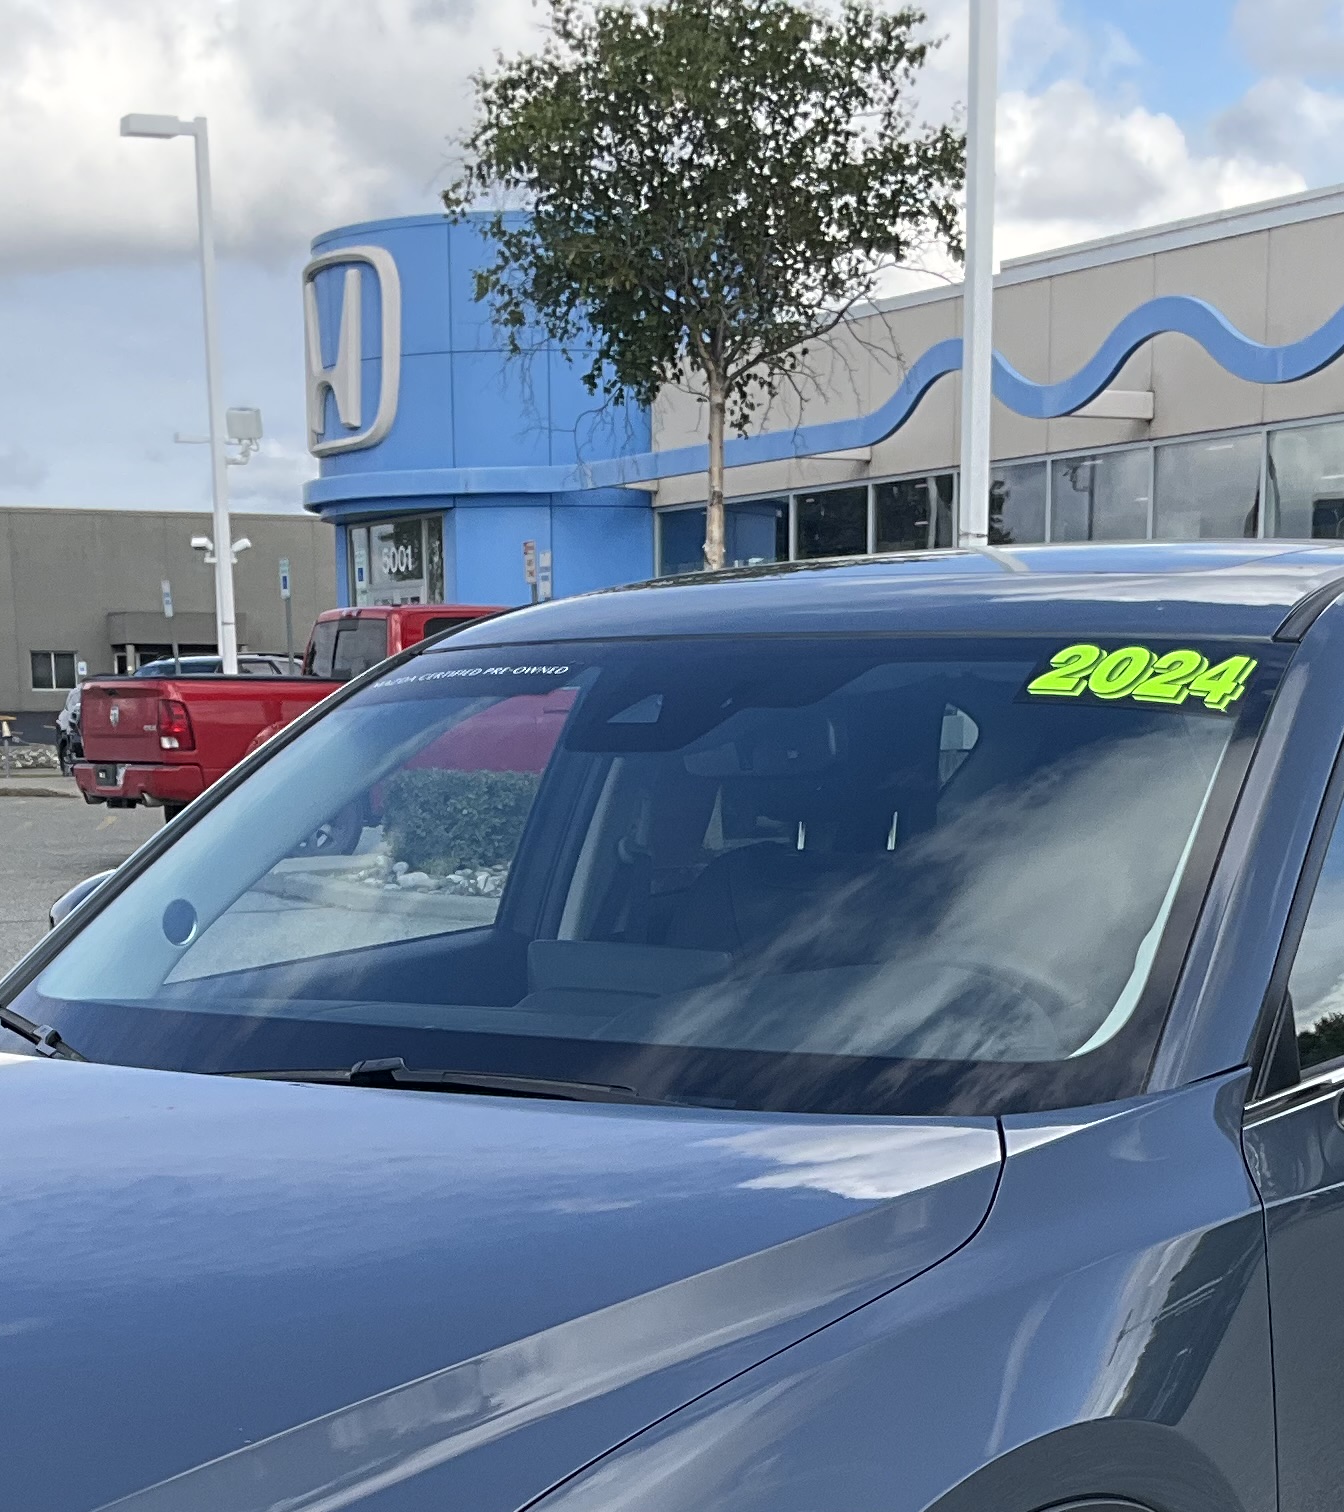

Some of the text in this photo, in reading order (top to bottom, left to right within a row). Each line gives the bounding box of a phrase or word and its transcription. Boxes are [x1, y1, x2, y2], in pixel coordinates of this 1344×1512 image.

[382, 545, 413, 574] 5001
[418, 667, 483, 681] CERTIFIED
[483, 665, 570, 676] PRE-OWNED
[1026, 643, 1259, 713] 2024
